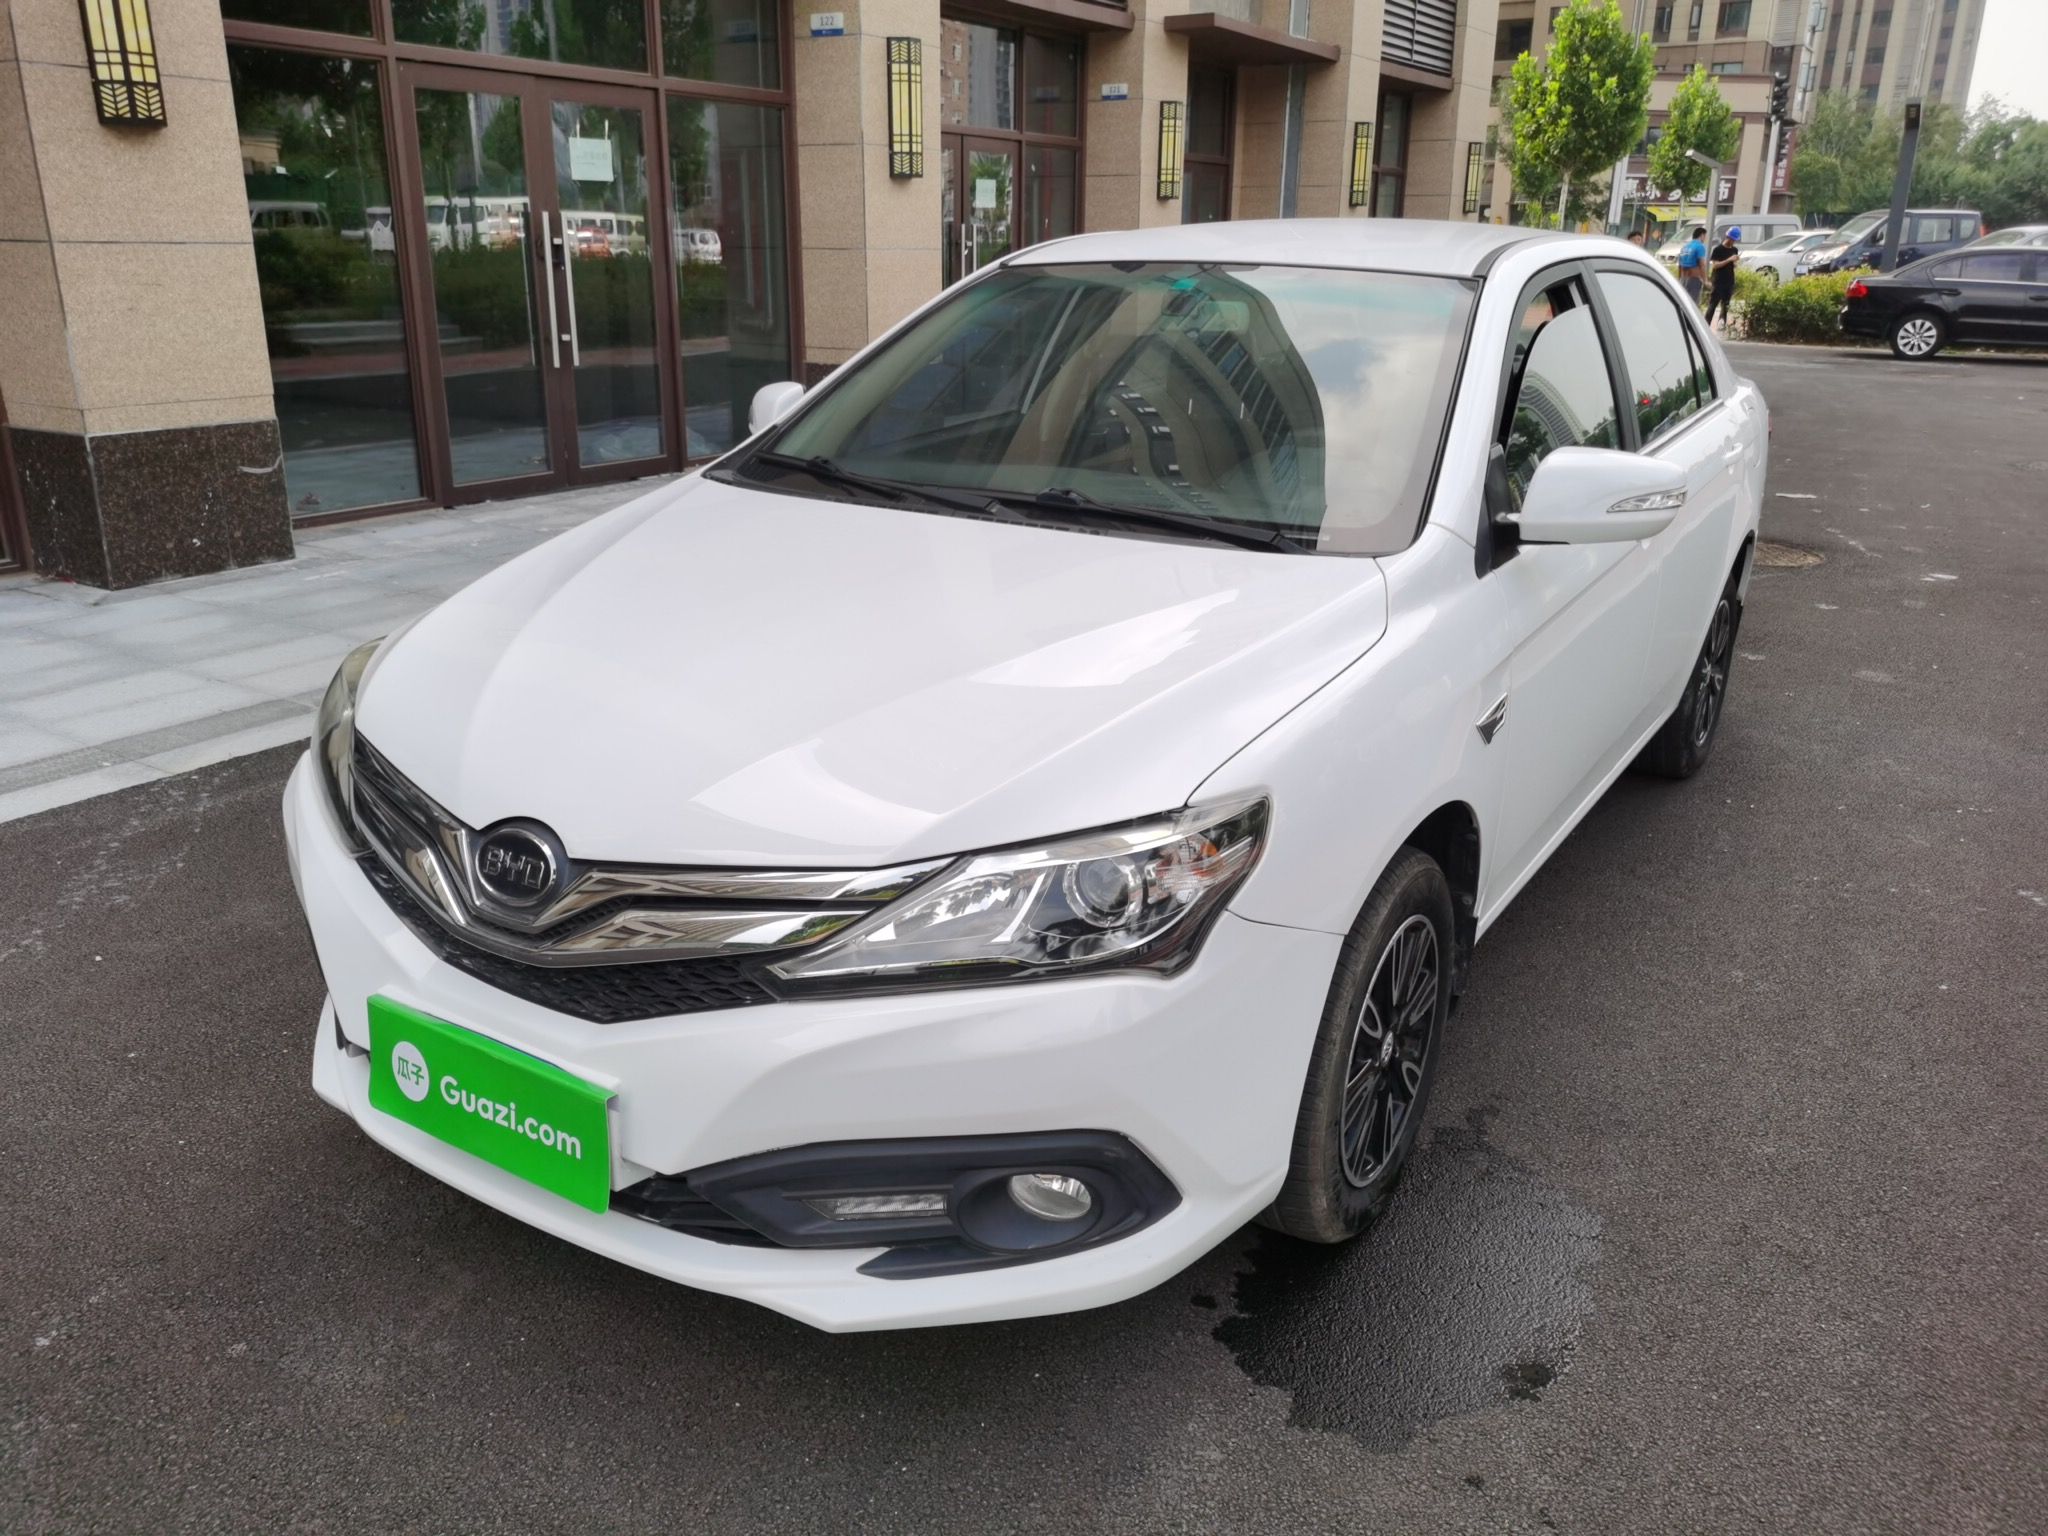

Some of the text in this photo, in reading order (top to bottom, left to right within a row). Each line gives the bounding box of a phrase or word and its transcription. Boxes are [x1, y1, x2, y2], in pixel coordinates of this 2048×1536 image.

[820, 15, 834, 26] 122
[483, 845, 545, 890] BYD
[396, 1055, 425, 1086] 瓜子
[439, 1075, 582, 1160] Guazi.com
